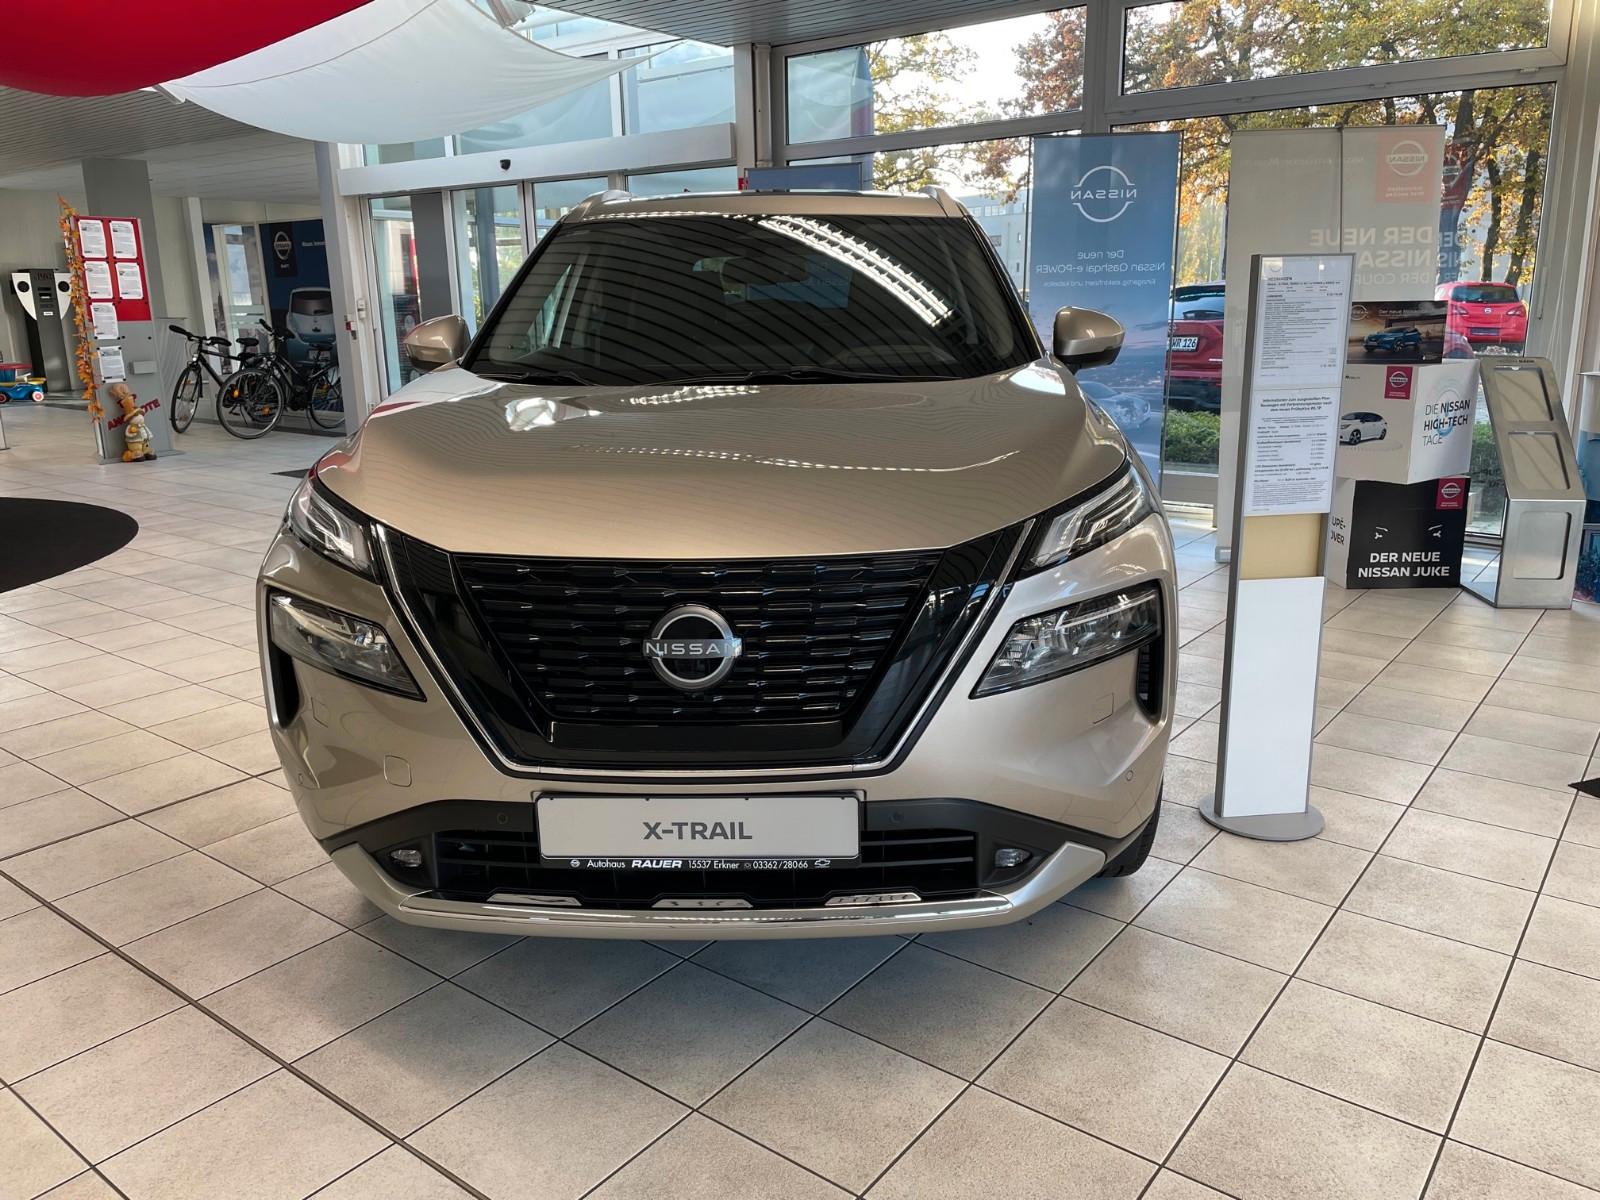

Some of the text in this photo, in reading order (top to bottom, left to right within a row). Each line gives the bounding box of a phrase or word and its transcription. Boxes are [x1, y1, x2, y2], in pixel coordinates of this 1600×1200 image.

[1182, 338, 1197, 347] 126
[1425, 399, 1471, 415] DIE NISSAN
[1423, 415, 1469, 431] HIGH-TECH
[1370, 551, 1440, 564] DER NEUE
[1358, 565, 1450, 578] NISSAN JUKE
[643, 821, 753, 840] X-TRAIL
[587, 859, 809, 870] Autohaus RAUER 15537 Erkner 03362/28066
